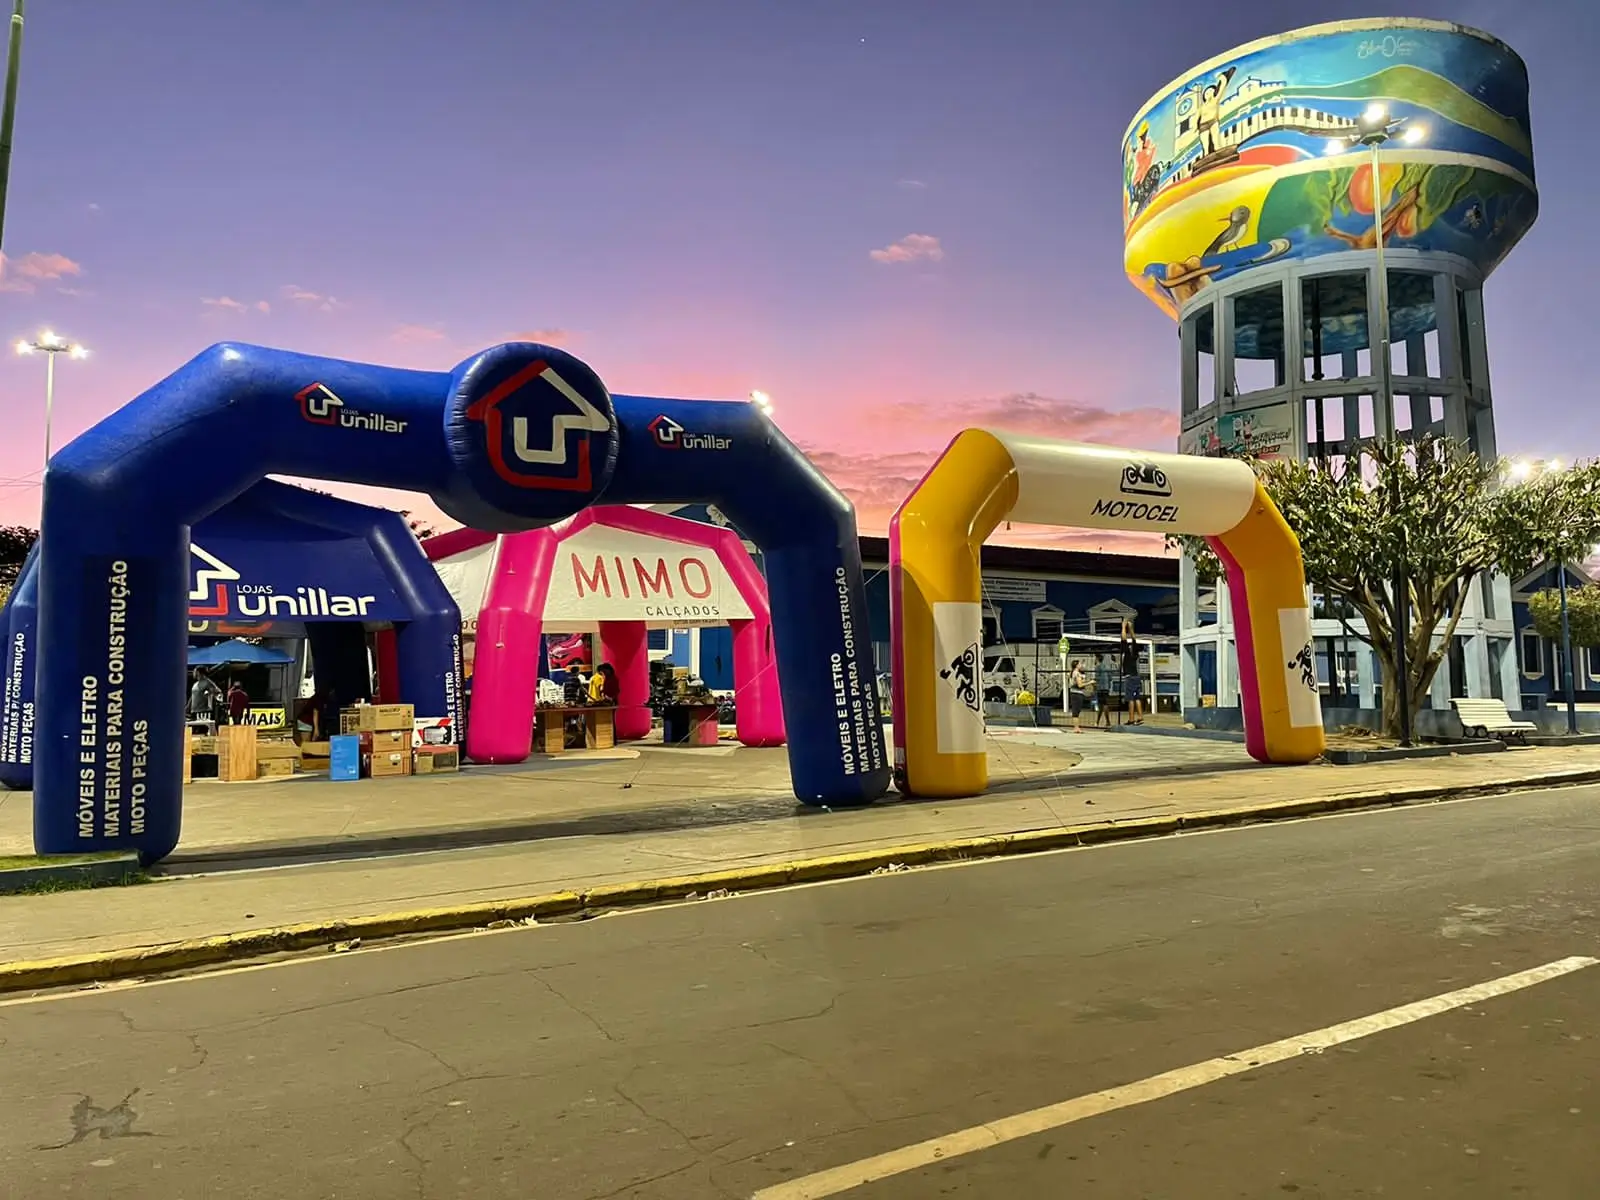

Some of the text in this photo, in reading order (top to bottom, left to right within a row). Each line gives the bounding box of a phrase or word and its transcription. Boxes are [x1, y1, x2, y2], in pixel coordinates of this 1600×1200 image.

[340, 413, 408, 433] unillar
[683, 434, 732, 449] unillar
[1090, 499, 1179, 522] MOTOCEL
[236, 584, 273, 594] LOJAS
[571, 553, 712, 599] MIMO
[238, 587, 375, 616] unillar
[645, 605, 720, 618] CALÇADOS
[445, 671, 455, 703] ELETRO
[835, 567, 870, 773] MATERIAIS PARA CONSTRUÇÃO
[104, 560, 131, 837] MATERIAIS PARA CONSTRUÇÃO
[830, 653, 855, 775] MÓVEIS E ELETRO
[20, 702, 36, 764] MOTO PEÇAS
[244, 711, 283, 726] MAIS
[76, 675, 98, 837] MÓVEIS E ELETRO
[870, 731, 881, 769] MOTO
[130, 719, 151, 834] MOTO PEÇAS
